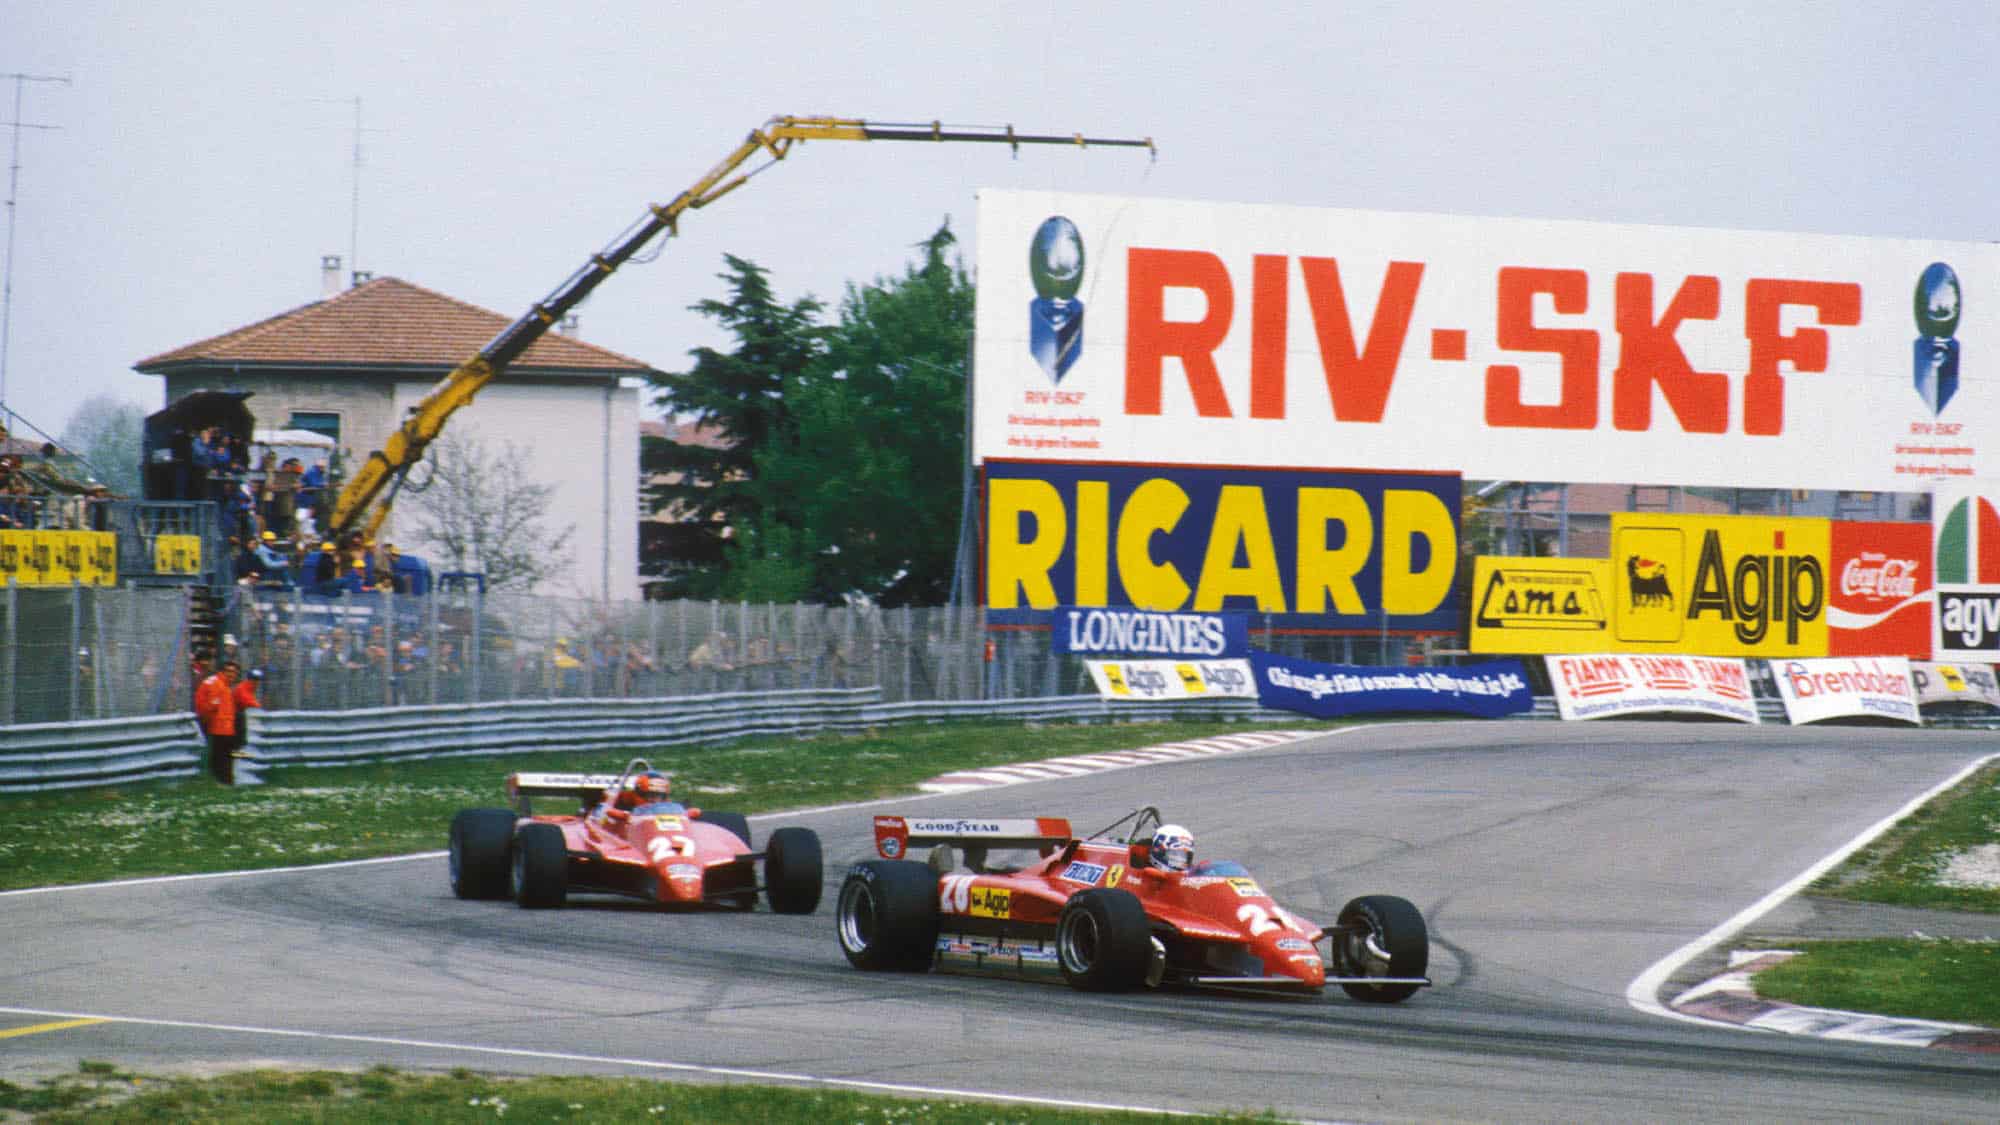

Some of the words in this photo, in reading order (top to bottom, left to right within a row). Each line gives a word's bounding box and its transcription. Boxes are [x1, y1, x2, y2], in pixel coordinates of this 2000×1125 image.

[1126, 248, 1860, 435] RIV-SKF
[989, 479, 1456, 614] RICARD
[1687, 530, 1823, 645] Agip
[1068, 611, 1226, 656] LONGINES
[1943, 597, 2000, 648] agv
[1559, 657, 1629, 686] FIAMM
[1629, 657, 1695, 679] FIAMM
[648, 835, 695, 863] 27
